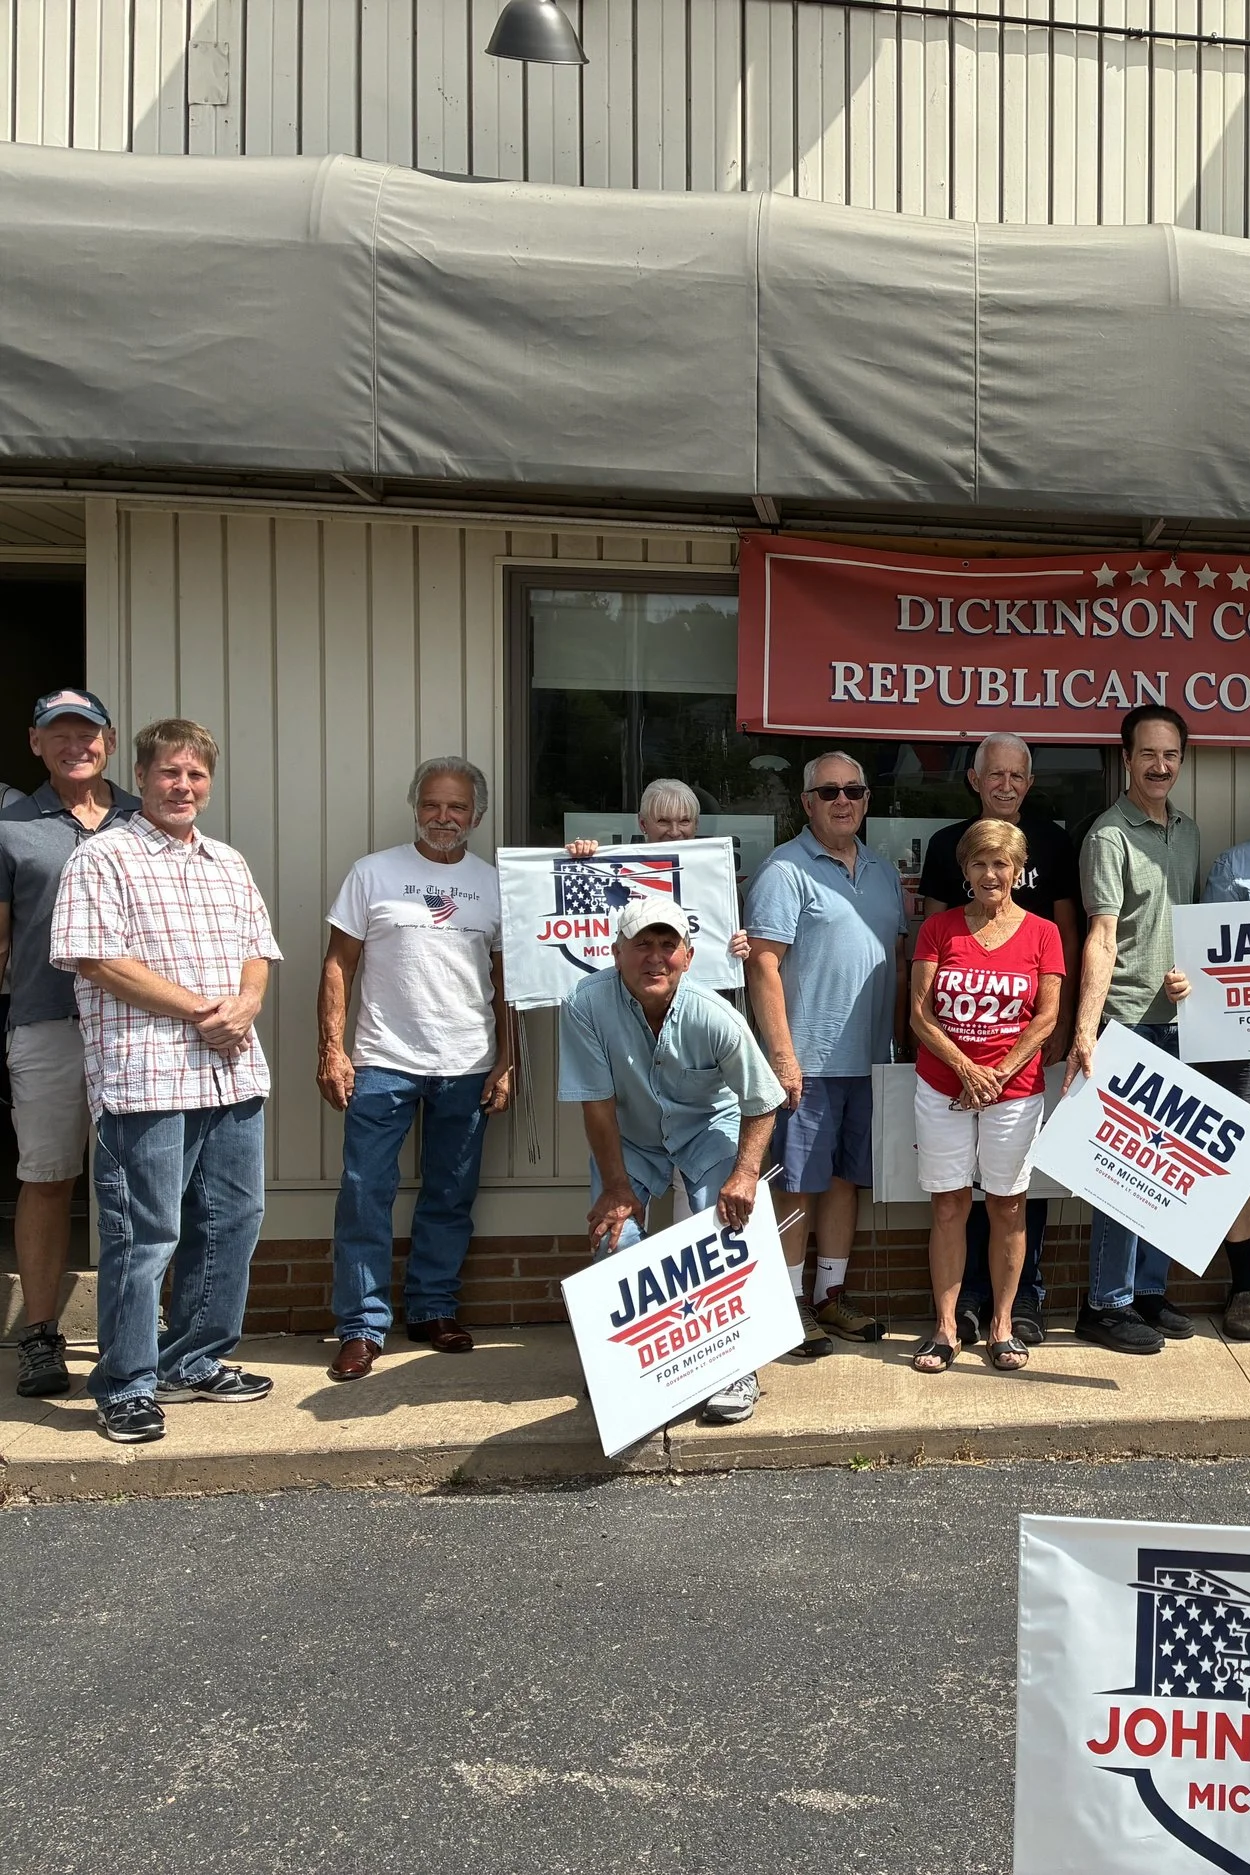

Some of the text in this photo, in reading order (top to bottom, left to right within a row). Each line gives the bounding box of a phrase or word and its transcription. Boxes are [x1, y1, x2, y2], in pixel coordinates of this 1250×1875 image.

[896, 594, 1197, 639] DICKINSON
[830, 660, 1170, 709] REPUBLICAN
[403, 884, 480, 900] We The People
[536, 918, 610, 941] JOHN
[936, 971, 1029, 997] TRUMP
[936, 991, 1024, 1024] 2024
[947, 1025, 975, 1035] AMERICA
[1108, 1062, 1246, 1163] JAMES
[1094, 1153, 1170, 1207] FOR MICHIGAN
[1095, 1120, 1195, 1196] DEBOYER
[1095, 1167, 1120, 1186] GOVERNOR
[1132, 1192, 1158, 1210] GOVERNOR
[610, 1226, 749, 1328] JAMES
[638, 1295, 746, 1369] DEBOYER
[656, 1330, 740, 1383] FOR MICHIGAN
